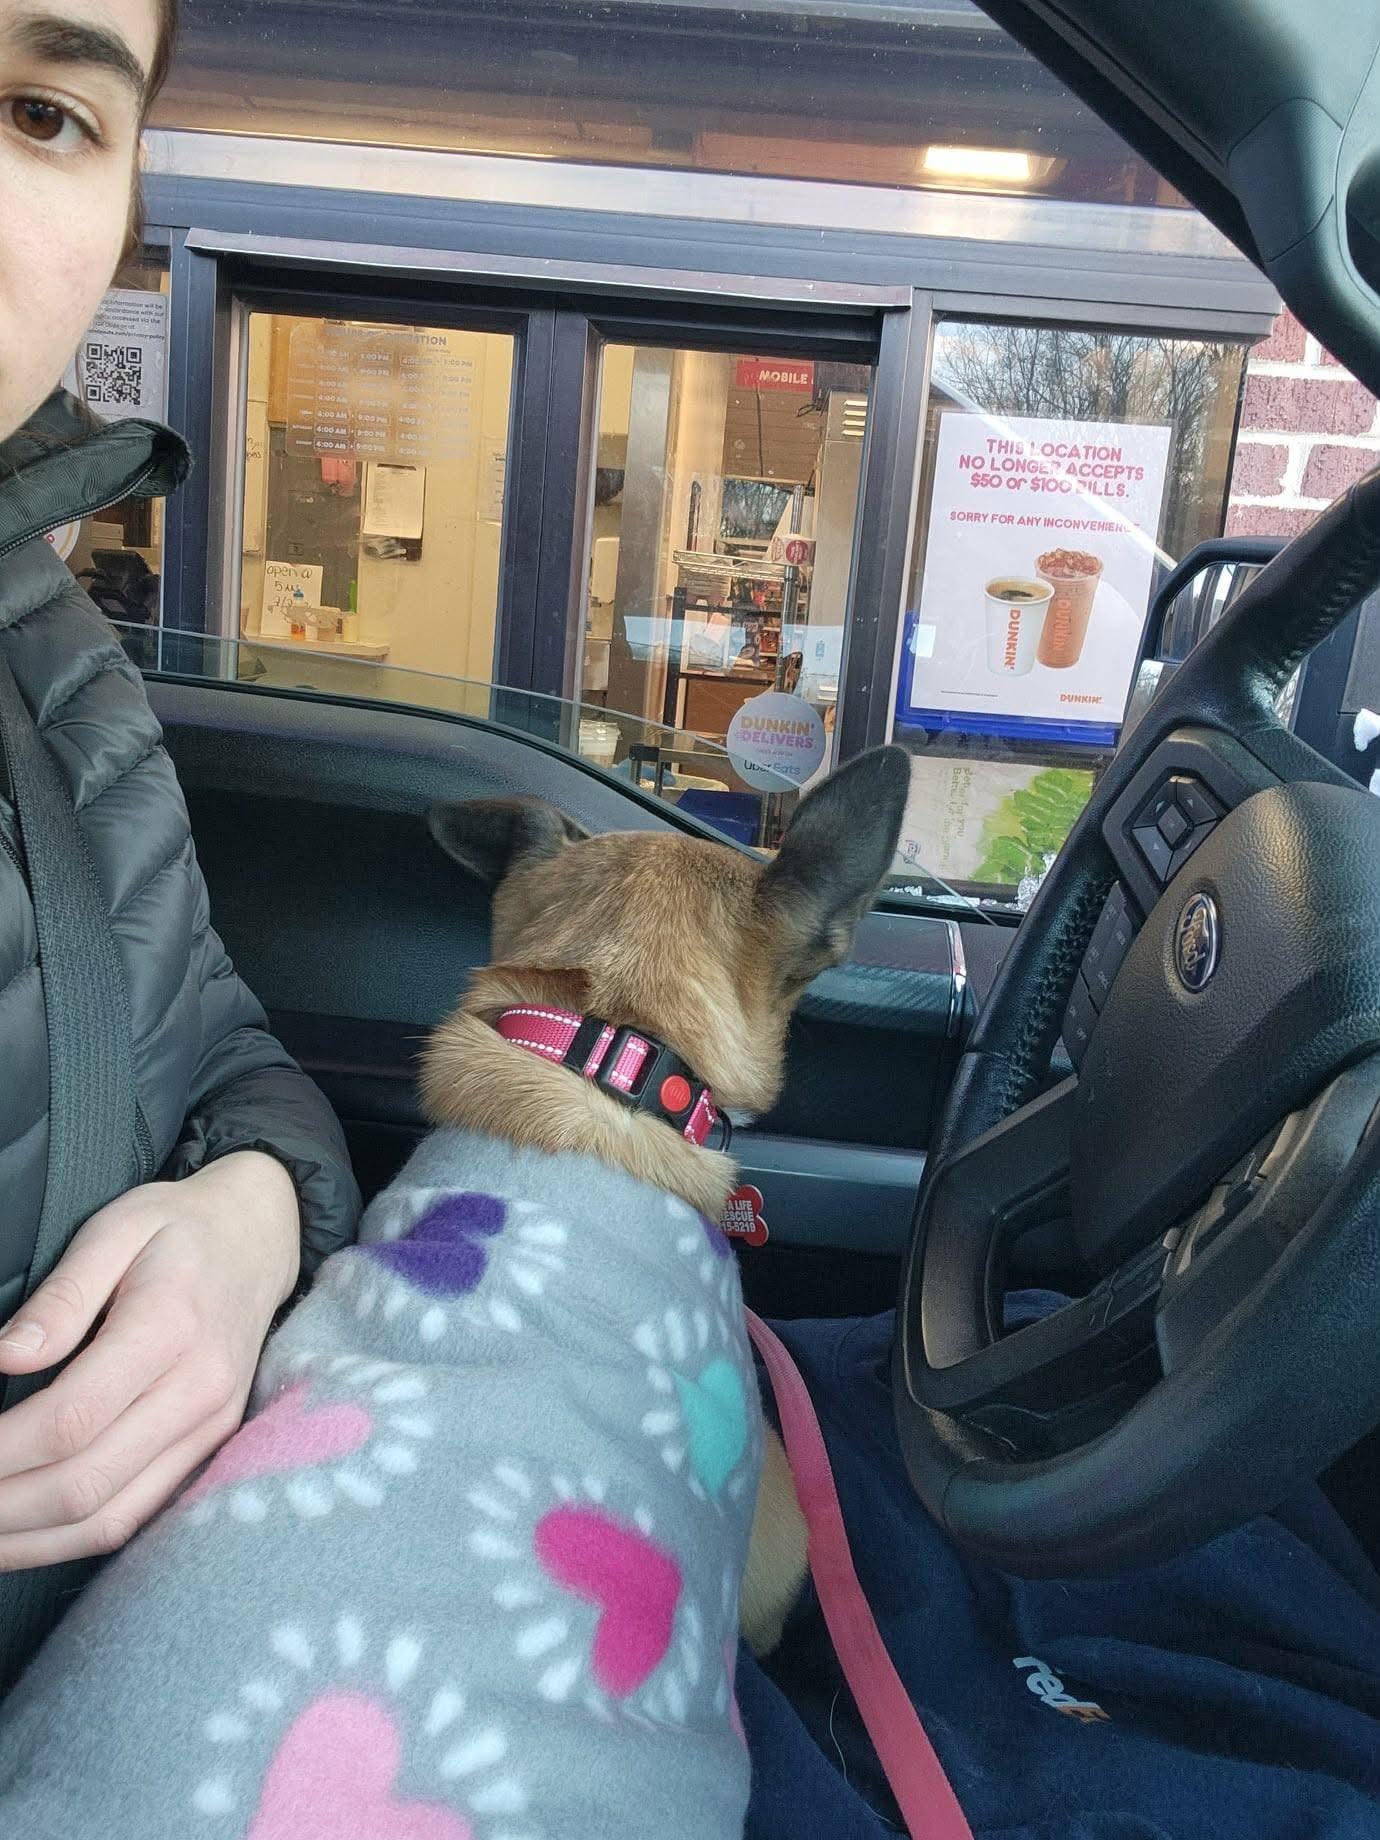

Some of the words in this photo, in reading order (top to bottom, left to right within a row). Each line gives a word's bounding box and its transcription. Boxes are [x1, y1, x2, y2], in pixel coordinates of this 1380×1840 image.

[759, 370, 808, 385] MOBILE
[986, 439, 1024, 456] THIS
[1029, 441, 1122, 462] LOCATION
[959, 455, 985, 470] NO
[1065, 462, 1144, 481] ACCEPTS
[970, 472, 1003, 488] $50
[1006, 476, 1028, 490] or
[1030, 476, 1072, 494] $100
[950, 511, 989, 524] SORRY
[991, 513, 1014, 525] FOR
[1017, 515, 1042, 527] ANY
[1043, 517, 1140, 533] INCONVENIEN
[1004, 608, 1021, 670] DUNKIN'
[740, 716, 815, 736] DUNKIN'
[741, 731, 814, 749] DELIVERS
[728, 1199, 734, 1210] A
[734, 1199, 753, 1211] LIFE
